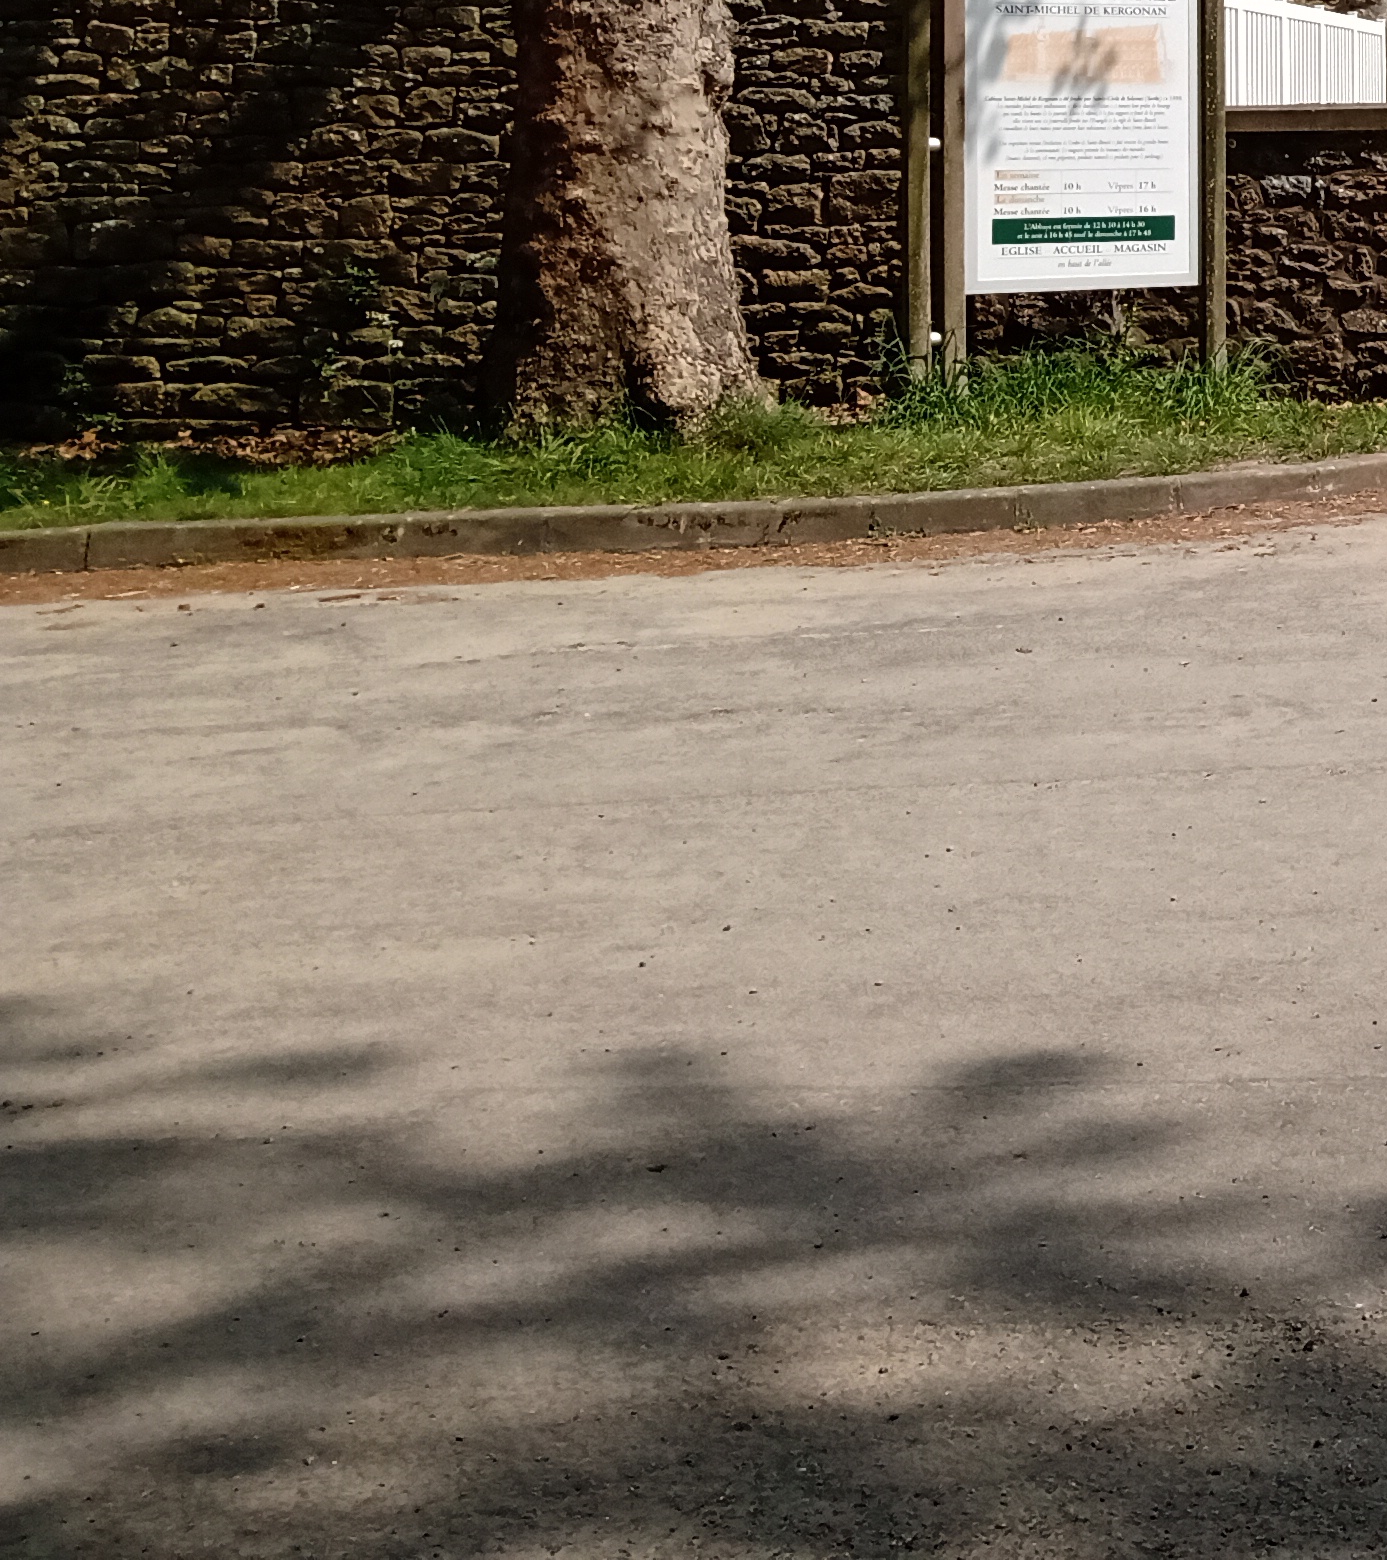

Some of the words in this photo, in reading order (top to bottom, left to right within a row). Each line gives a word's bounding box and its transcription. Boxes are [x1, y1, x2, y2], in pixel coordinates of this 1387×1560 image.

[995, 4, 1080, 15] SAINT-MICHEL
[1084, 5, 1099, 15] DE
[1103, 6, 1167, 16] KERGONAN
[994, 183, 1018, 191] Messe
[1020, 182, 1050, 191] chantée
[1063, 182, 1074, 191] 10
[1139, 181, 1149, 190] 17
[993, 208, 1018, 216] Messe
[1020, 207, 1050, 216] chantée
[1063, 206, 1074, 215] 10
[1139, 205, 1149, 213] 16
[1001, 245, 1042, 256] EGLISE
[1053, 244, 1103, 255] ACCUEIL
[1114, 242, 1167, 253] MAGASIN
